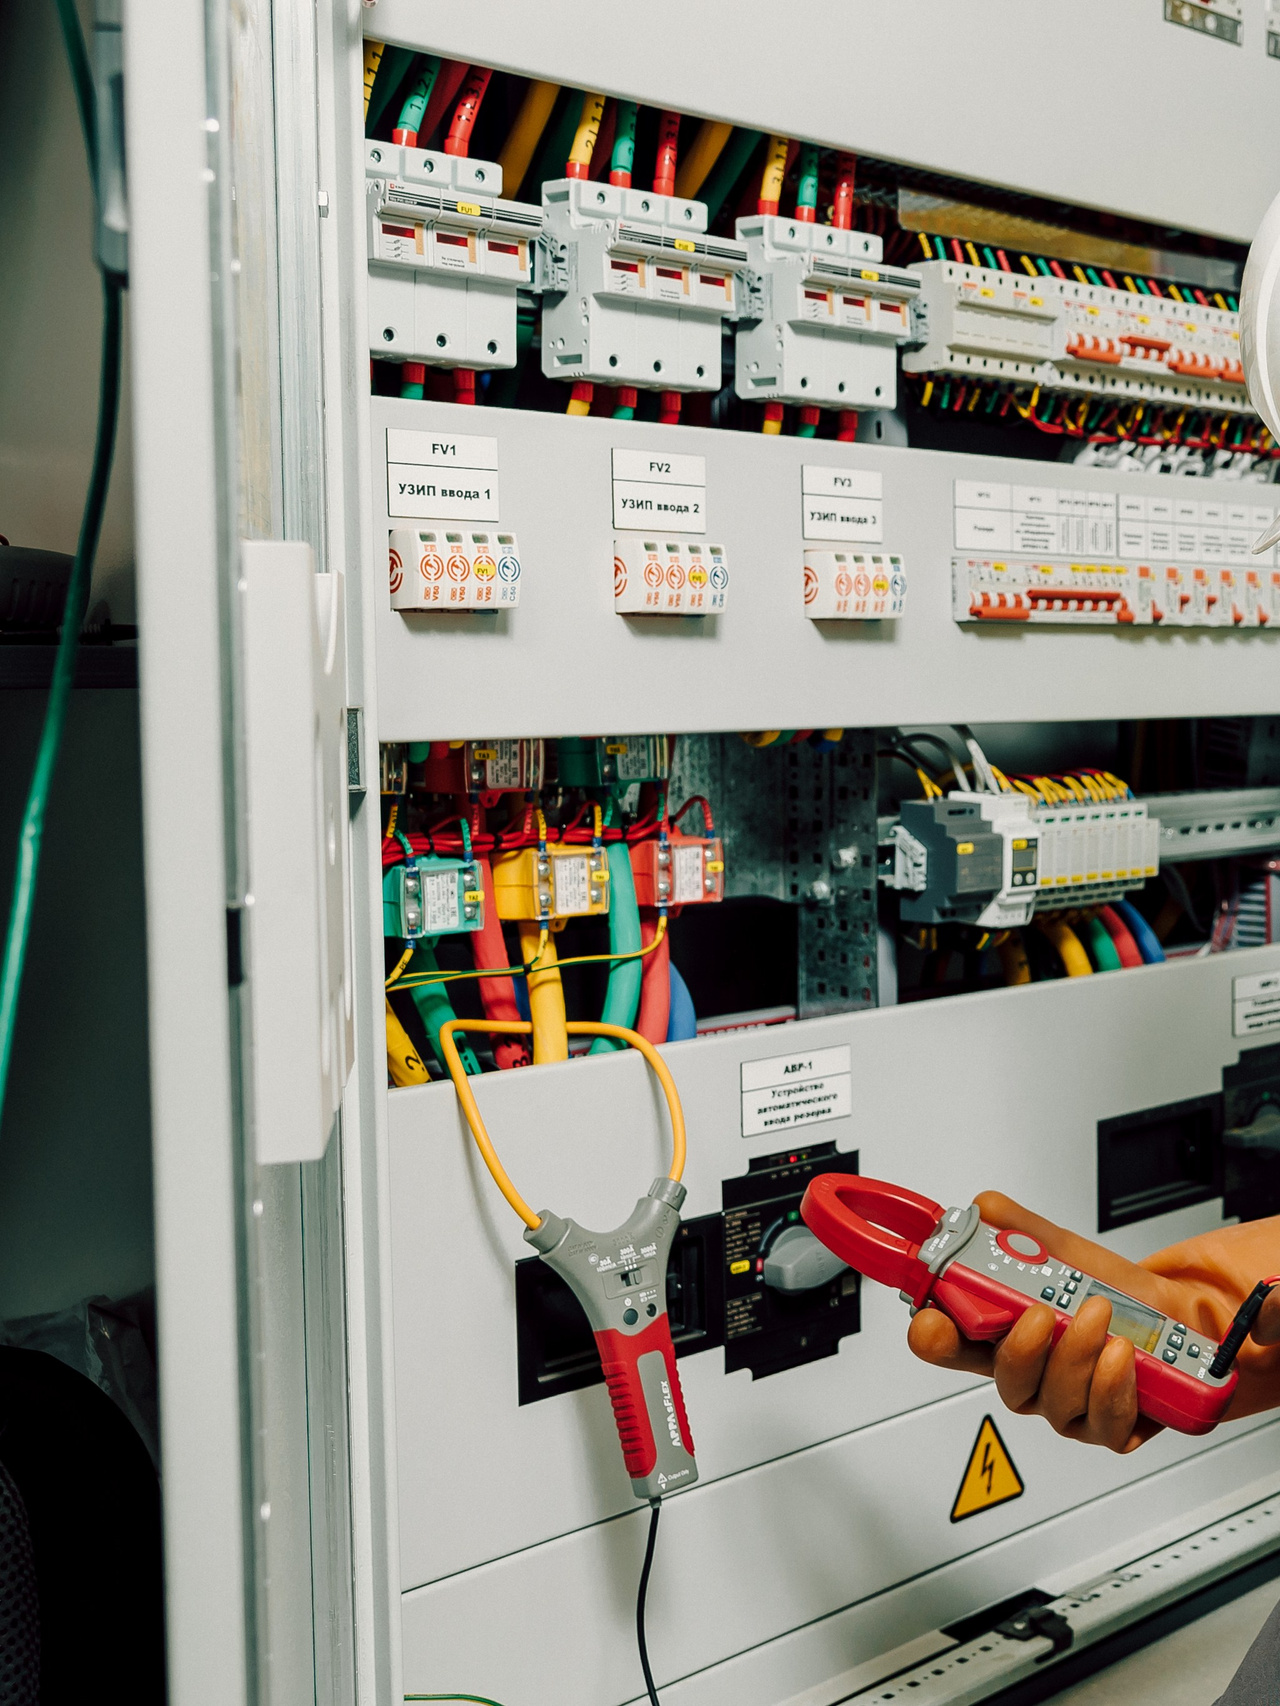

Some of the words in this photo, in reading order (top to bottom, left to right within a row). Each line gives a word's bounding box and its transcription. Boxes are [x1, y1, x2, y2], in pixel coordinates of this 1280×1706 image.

[461, 206, 473, 214] FU1
[432, 443, 456, 456] FV1
[649, 462, 671, 473] FV2
[834, 477, 852, 488] FV3
[398, 483, 436, 497] УЗИП
[441, 489, 480, 501] ввода
[484, 488, 491, 500] 1
[621, 498, 653, 510] УЗИП
[657, 503, 689, 514] ввода
[693, 503, 700, 514] 2
[810, 511, 837, 522] УЗИП
[771, 1082, 825, 1099] Устройство
[757, 1093, 839, 1115] автоматического
[763, 1116, 791, 1127] ввода
[793, 1107, 832, 1122] резерва
